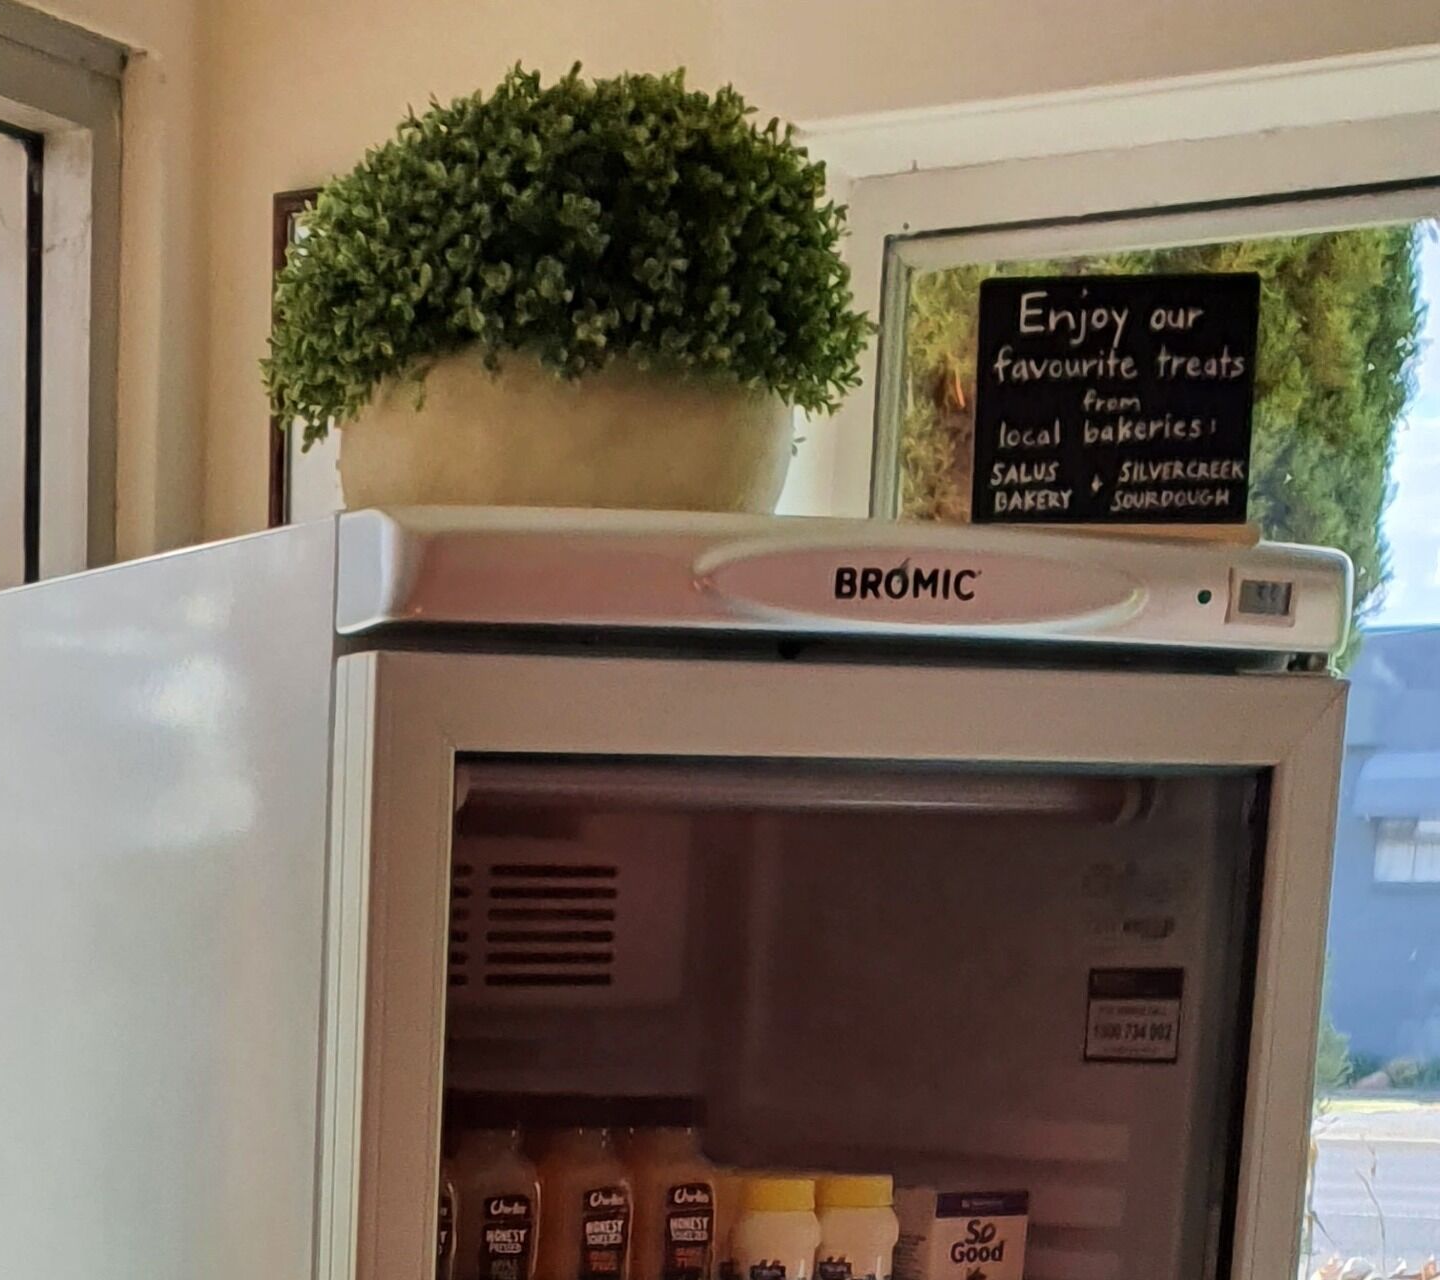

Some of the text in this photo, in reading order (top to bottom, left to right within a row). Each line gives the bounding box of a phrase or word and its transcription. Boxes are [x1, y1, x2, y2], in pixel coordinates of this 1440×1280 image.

[1019, 288, 1205, 347] Enjoy our
[993, 344, 1246, 383] favourite treats
[1083, 388, 1142, 412] from
[997, 417, 1061, 449] local
[990, 459, 1245, 486] SALUS SILVERCREEK
[995, 488, 1230, 512] BAKERY SOURDOUGH
[834, 562, 978, 601] BROMIC
[965, 1219, 997, 1245] So
[950, 1240, 1006, 1263] Good
